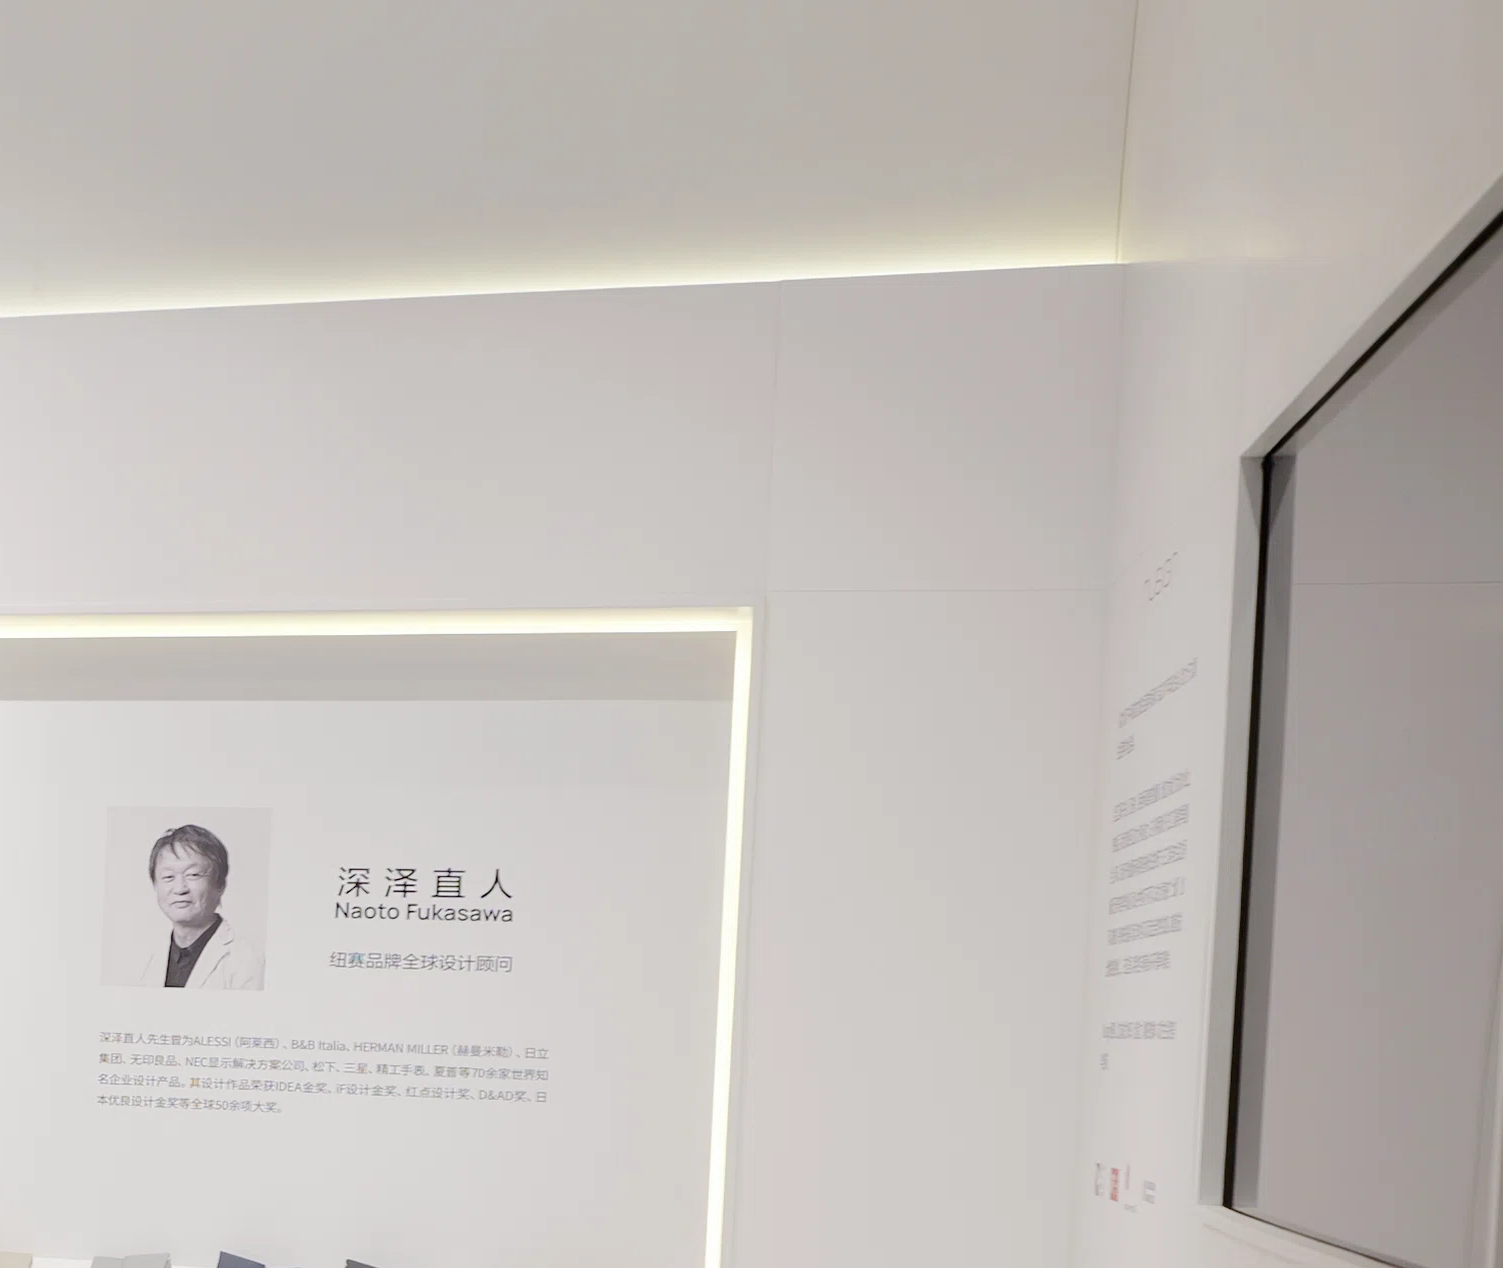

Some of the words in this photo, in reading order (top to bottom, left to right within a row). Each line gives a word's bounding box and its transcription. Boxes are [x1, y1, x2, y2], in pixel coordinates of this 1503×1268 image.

[338, 866, 512, 898] 深泽直人
[335, 902, 400, 920] Naoto
[406, 903, 513, 922] Fukasawa
[329, 951, 513, 973] 纽赛品牌全球设计顾问
